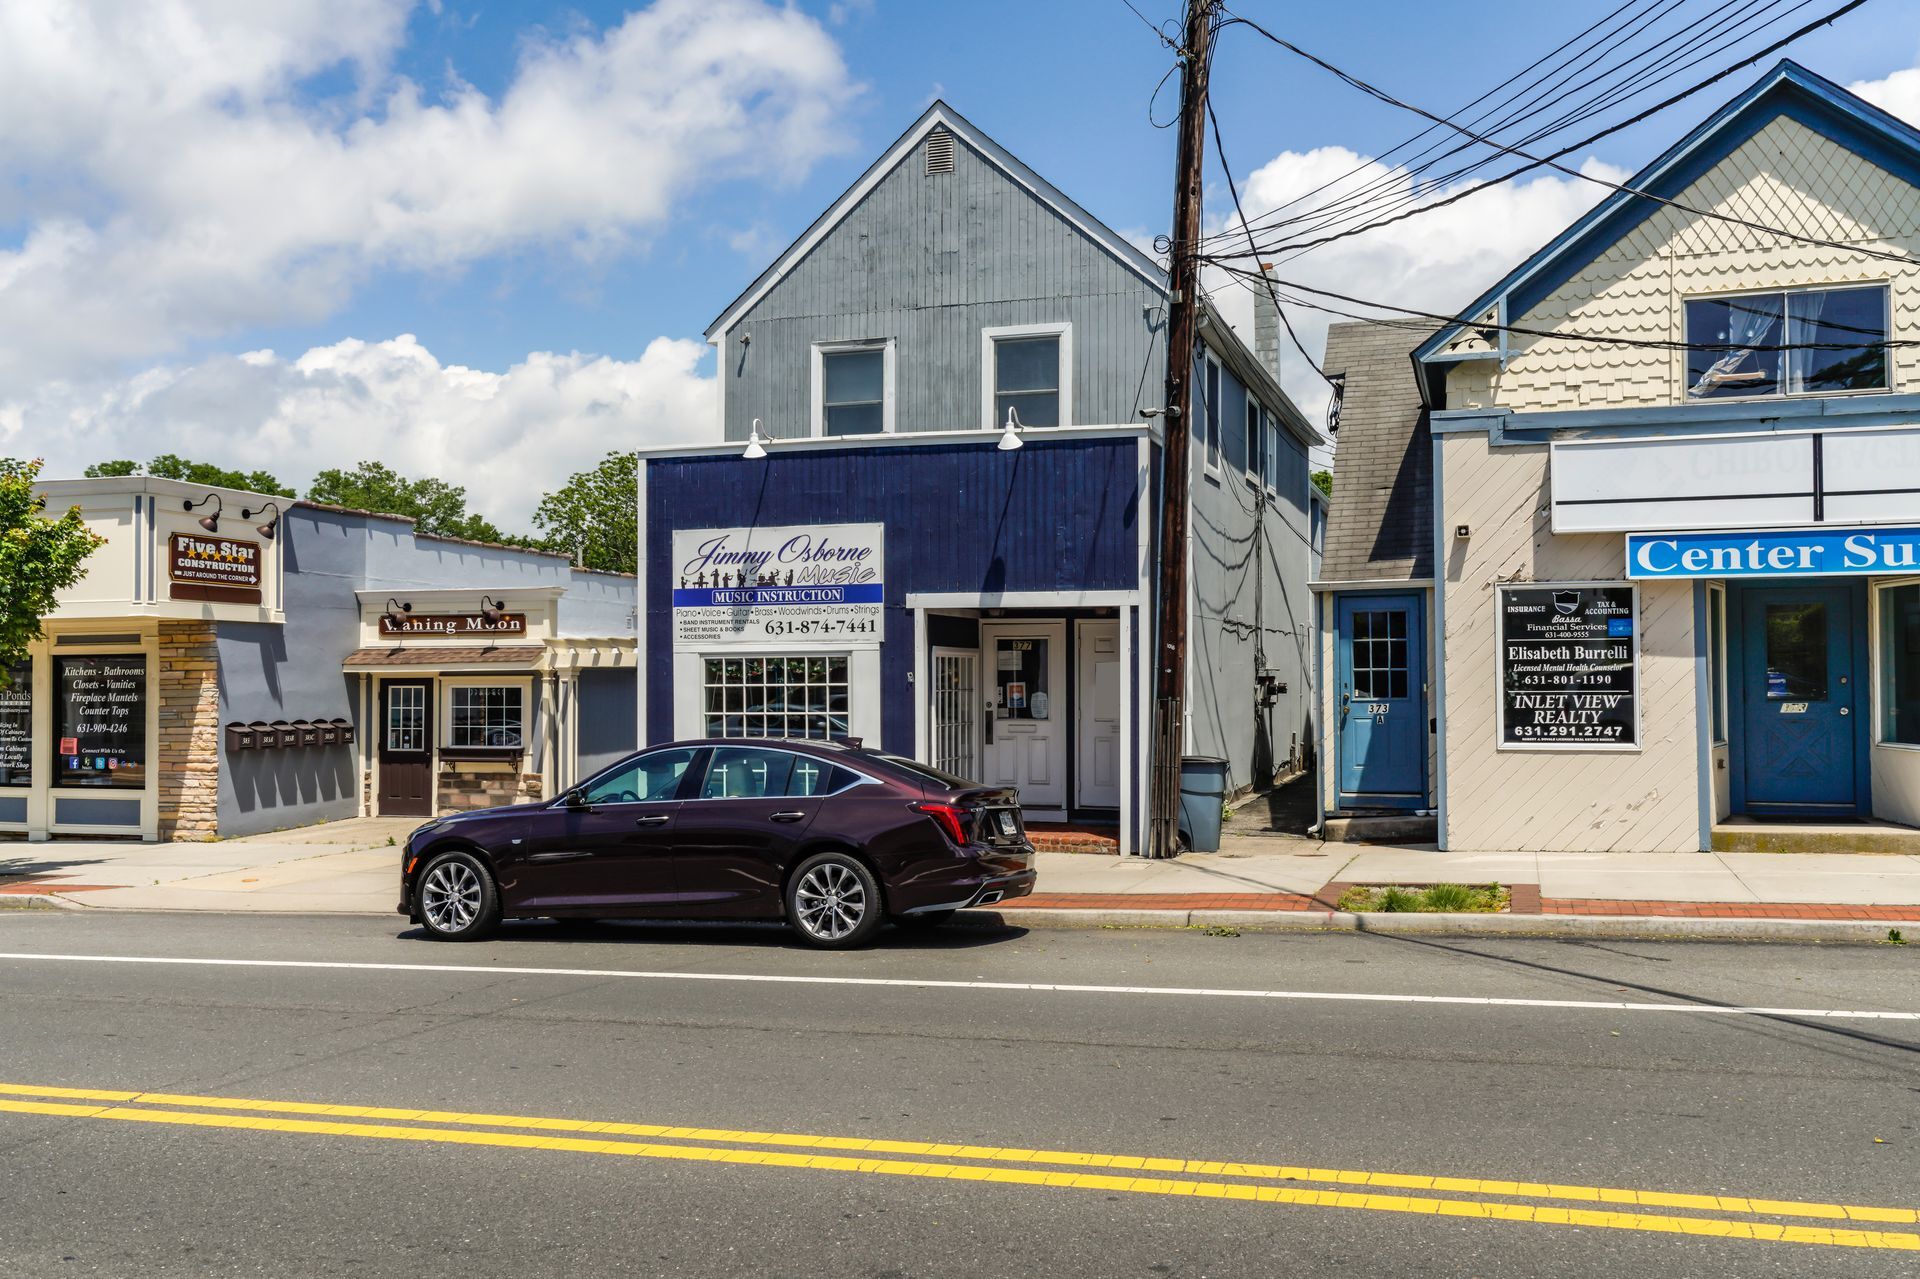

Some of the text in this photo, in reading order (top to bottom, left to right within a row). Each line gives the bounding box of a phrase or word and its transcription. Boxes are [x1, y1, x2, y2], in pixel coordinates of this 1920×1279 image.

[178, 537, 254, 559] Five Star
[1637, 534, 1920, 572] Center Su
[684, 534, 872, 576] Jimmy Osborne
[178, 558, 254, 573] CONSTRUCTION
[797, 562, 876, 585] Music
[715, 589, 841, 602] MUSIC INSTRUCTION
[676, 605, 880, 617] Piano Voice Guitar Brass Woodwinds Drums Strings
[1552, 614, 1582, 623] Bassa
[765, 618, 876, 636] 631-874-7441
[1508, 645, 1628, 660] Elisabeth Burrelli
[64, 667, 97, 677] Kitchens
[104, 667, 144, 676] Bathrooms
[1513, 664, 1541, 672] Licensed
[72, 680, 100, 689] Closets
[106, 680, 136, 689] Vanities
[1524, 675, 1612, 685] 631-801-1190
[6, 690, 31, 700] Ponds
[70, 693, 138, 704] Fireplace Mantels
[1514, 694, 1622, 709] INLET VIEW
[79, 706, 129, 717] Counter Tops
[1369, 704, 1388, 713] 373
[1533, 710, 1603, 724] REALTY
[76, 724, 128, 733] 631-909-4246
[1514, 726, 1623, 736] 631.291.2747
